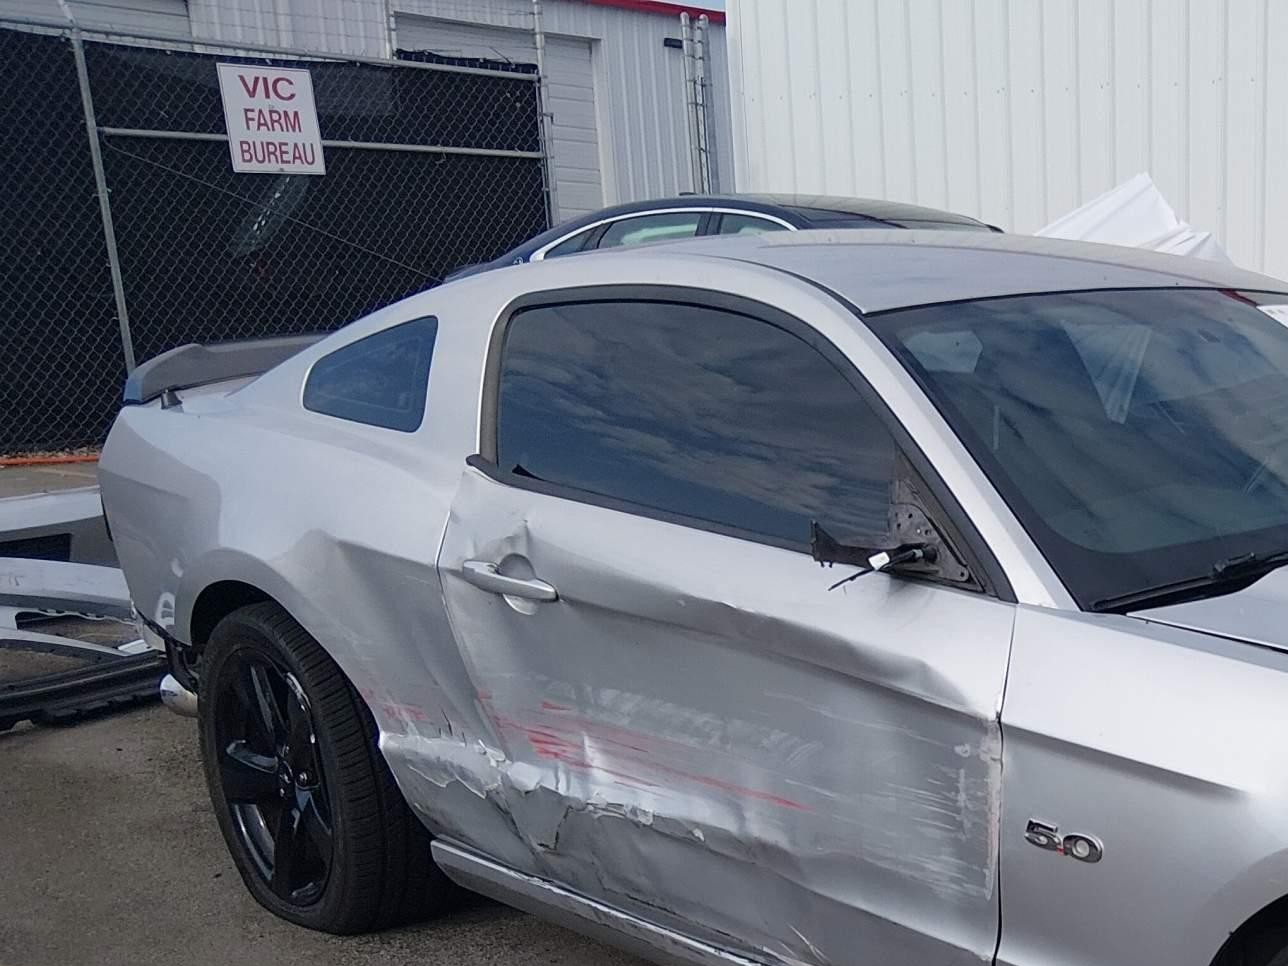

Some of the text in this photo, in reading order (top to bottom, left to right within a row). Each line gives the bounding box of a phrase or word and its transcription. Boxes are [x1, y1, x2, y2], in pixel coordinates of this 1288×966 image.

[238, 74, 296, 101] VIC
[243, 108, 302, 133] FARM
[239, 140, 316, 165] BUREAU
[1023, 817, 1105, 864] 5.0
